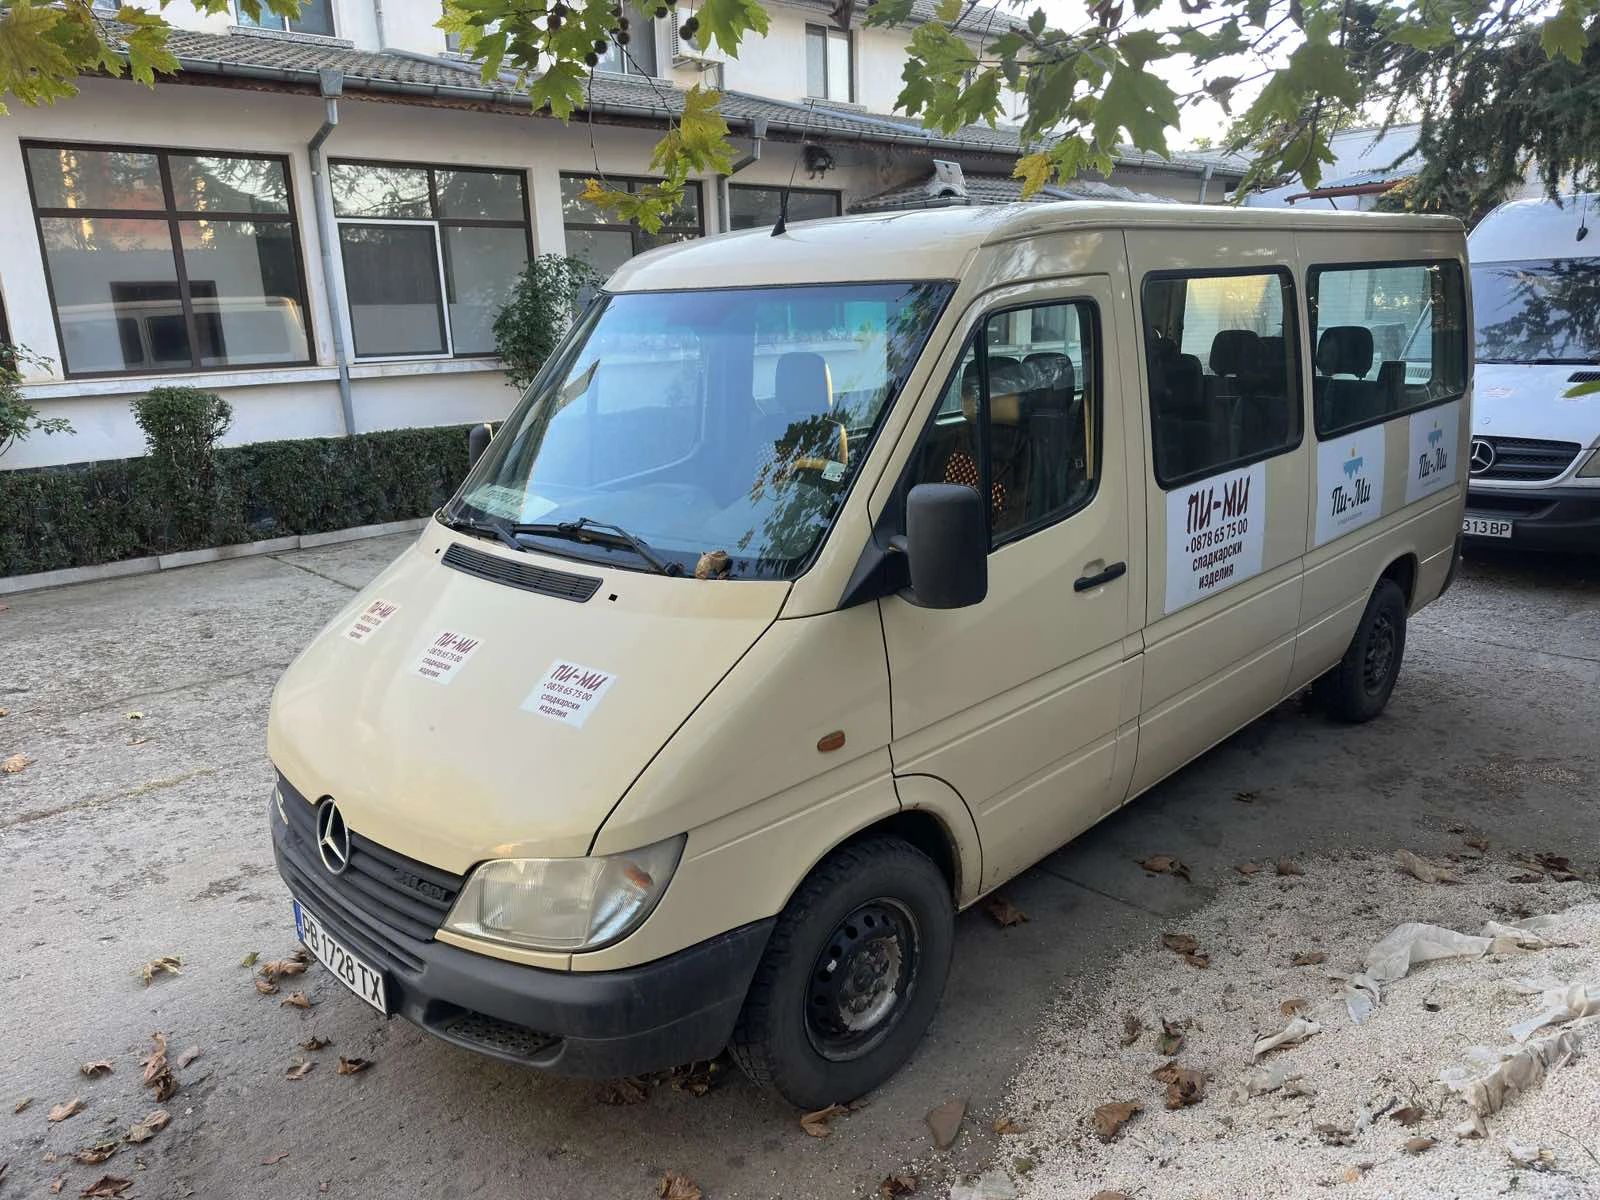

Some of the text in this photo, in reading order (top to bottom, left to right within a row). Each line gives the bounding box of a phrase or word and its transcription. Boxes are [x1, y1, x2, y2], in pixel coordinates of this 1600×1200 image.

[1187, 475, 1250, 534] ПИ-МИ
[1331, 478, 1371, 517] Пи-Ми
[1190, 518, 1248, 553] 0878 65 75 00
[1192, 541, 1242, 572] сладкарски
[1199, 563, 1234, 590] изделия
[434, 632, 480, 655] ПИ-МИ
[550, 664, 608, 691] ПИ-МИ
[541, 694, 581, 711] сладкарски
[302, 911, 383, 1007] PB 1728 TX
